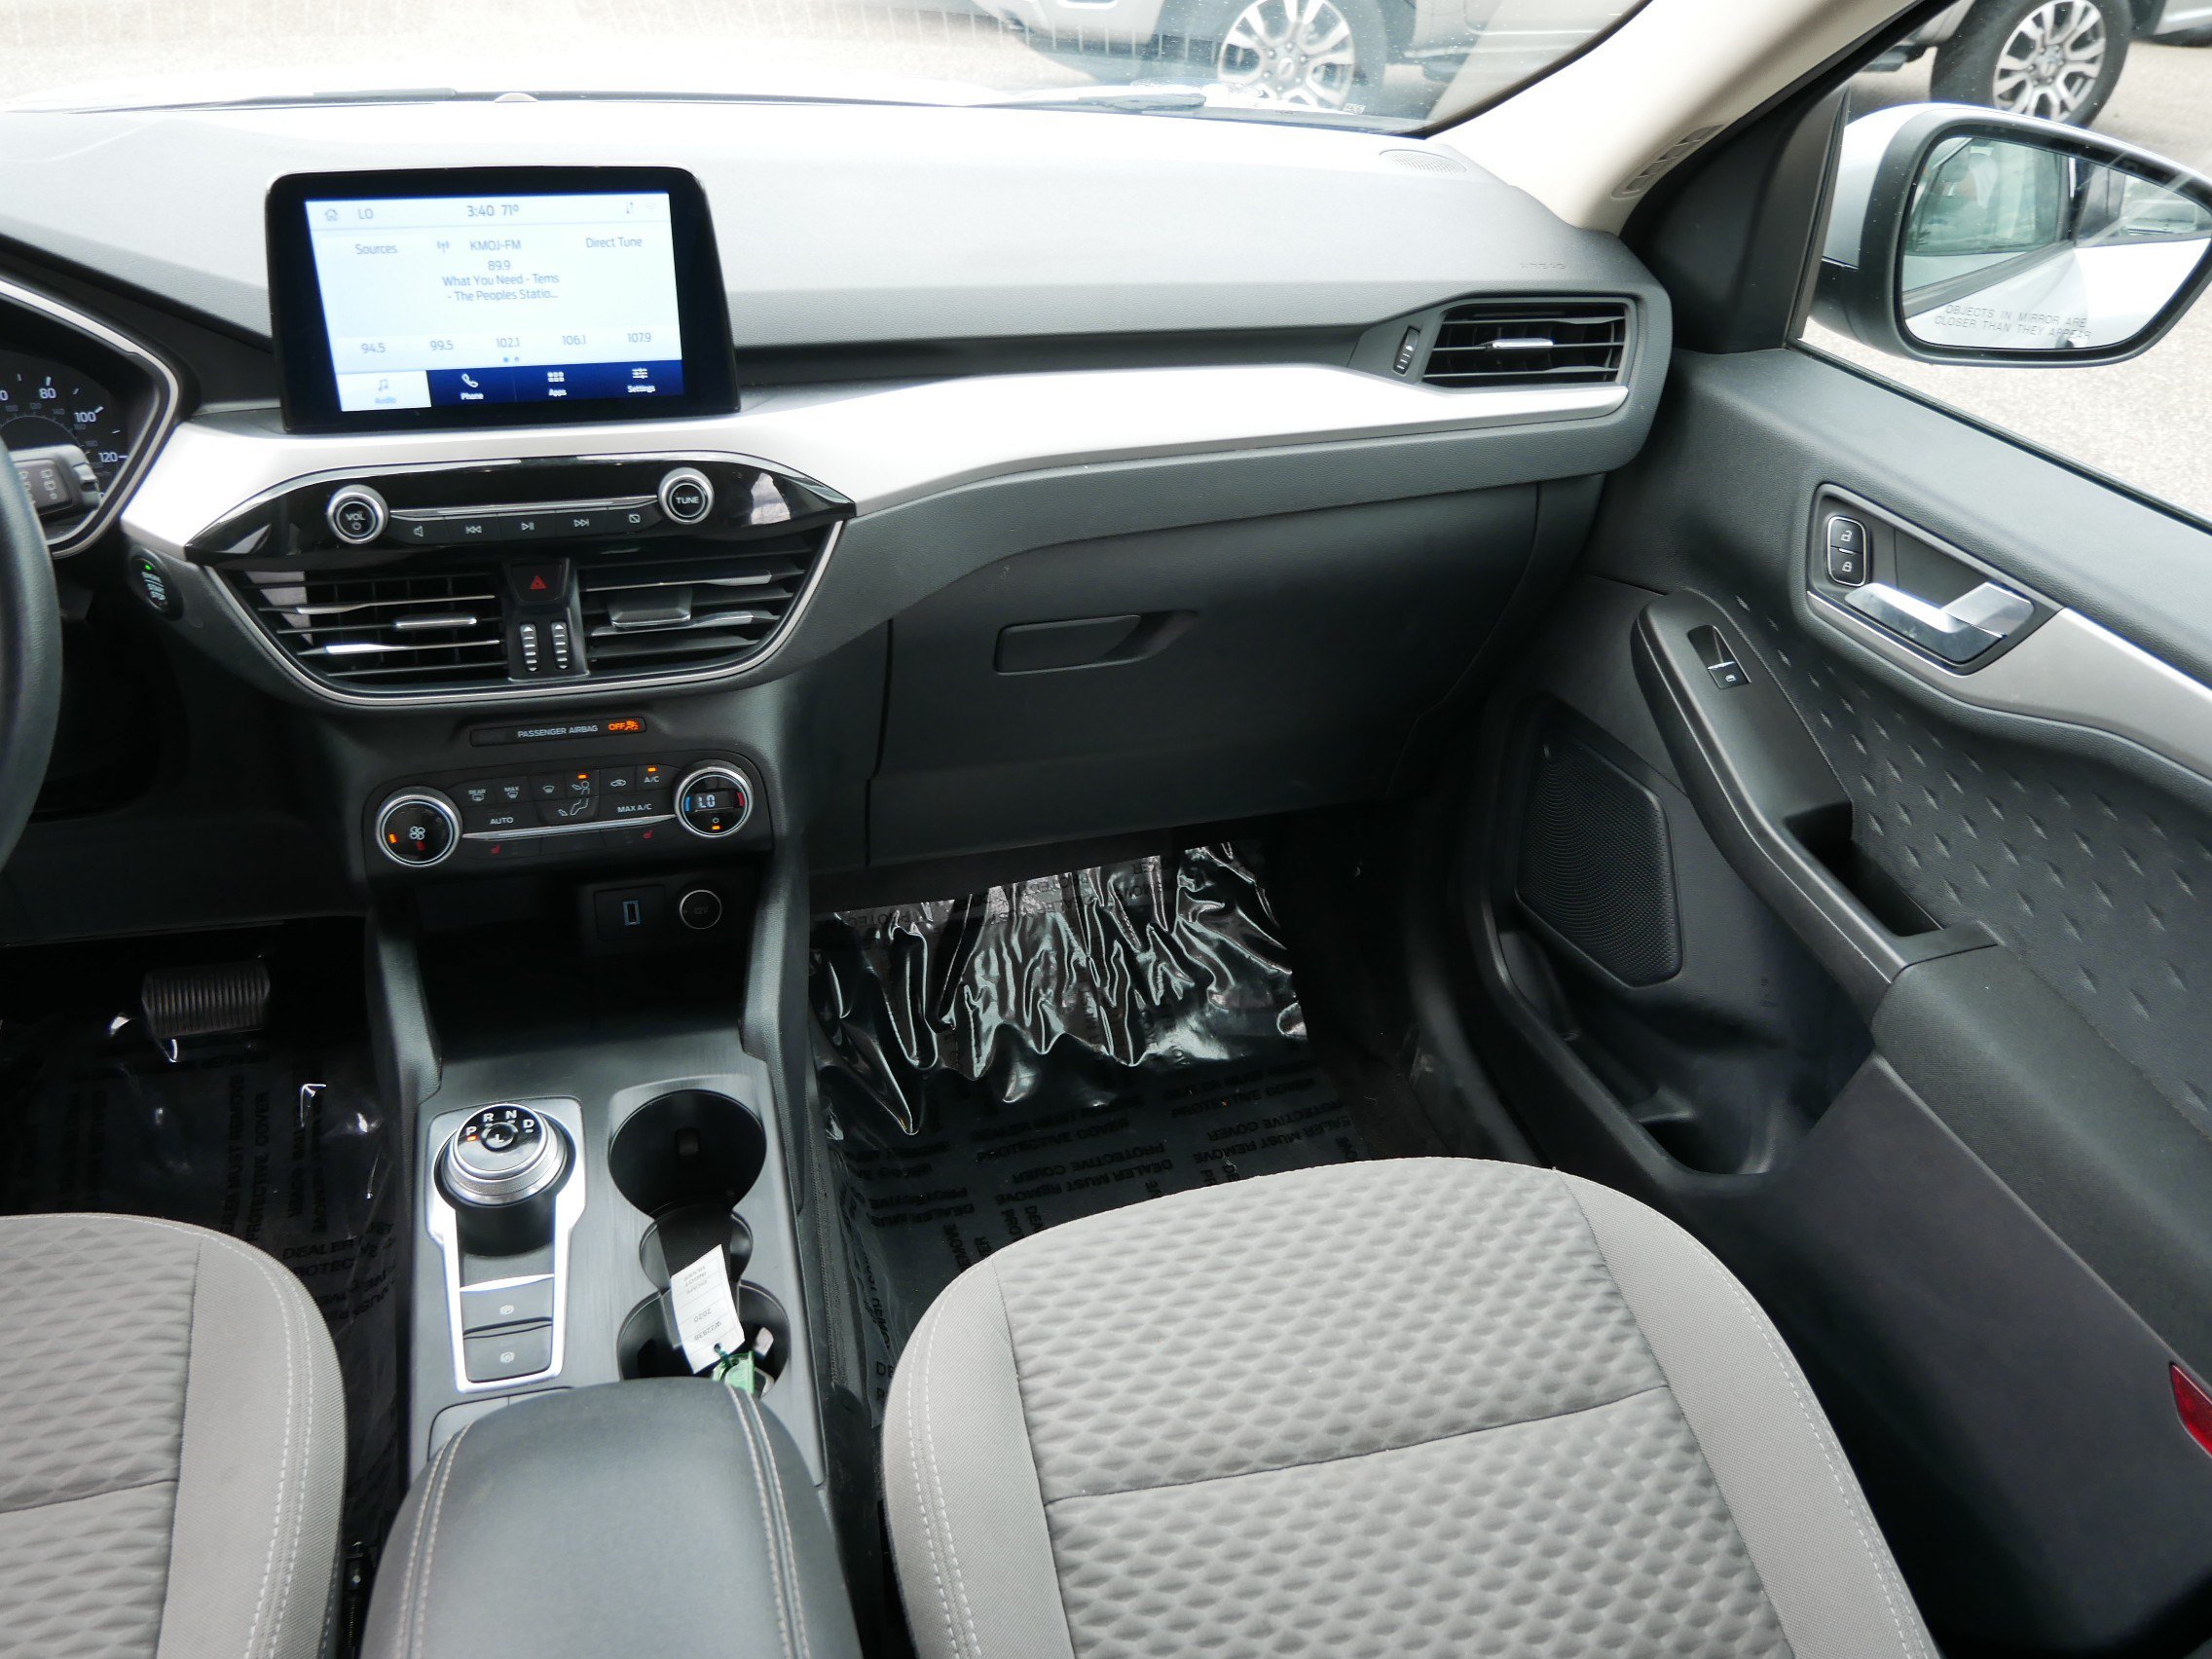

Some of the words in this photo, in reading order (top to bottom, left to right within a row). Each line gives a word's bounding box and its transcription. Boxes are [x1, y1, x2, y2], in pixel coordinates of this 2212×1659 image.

[357, 207, 375, 220] LO
[466, 204, 496, 218] 3:40
[468, 239, 522, 252] KMOJ-FM
[585, 236, 615, 248] Direct
[617, 236, 644, 247] Tune
[354, 242, 399, 255] Sources
[487, 260, 512, 272] 89.9
[441, 276, 471, 287] What
[472, 275, 495, 287] You
[495, 274, 525, 285] Need
[532, 273, 561, 284] Tems
[454, 290, 475, 302] The
[475, 289, 517, 303] Peoples
[1944, 304, 1995, 319] OBJECTS
[2000, 310, 2012, 320] IN
[2017, 312, 2061, 326] MIRROR
[2065, 316, 2088, 329] ARE
[1934, 314, 1977, 329] CLOSER
[1982, 320, 2012, 333] THAN
[2016, 322, 2046, 337] THEY
[495, 337, 521, 349] 102.1
[562, 334, 587, 347] 106.1
[626, 331, 653, 344] 107.9
[360, 343, 387, 354] 94.5
[429, 340, 455, 350] 99.5
[39, 387, 56, 399] 80
[548, 387, 568, 398] Apps
[626, 384, 656, 394] Settings
[374, 394, 397, 405] Audio
[460, 391, 485, 401] Phone
[74, 411, 97, 424] 100
[98, 452, 118, 462] 120
[675, 496, 700, 505] TUNE
[345, 511, 366, 522] VOL
[517, 726, 568, 739] PASSENGER
[569, 724, 599, 735] AIRBAG
[608, 721, 626, 732] OFF
[644, 775, 660, 785] A/C
[468, 788, 487, 797] REAR
[503, 786, 520, 794] MAX
[616, 804, 636, 814] MAX
[636, 801, 653, 812] A/C
[489, 816, 515, 826] AUTO
[484, 1113, 495, 1123] R
[505, 1110, 517, 1120] N
[523, 1120, 535, 1128] D
[1302, 1115, 1351, 1137] EALER
[465, 1126, 476, 1136] P
[1206, 1121, 1260, 1142] COVER
[495, 1133, 504, 1142] L
[1070, 1142, 1166, 1173] PROTECTIVE
[1192, 1140, 1258, 1163] REMOVE
[1012, 1164, 1066, 1186] COVER
[1113, 1159, 1174, 1183] DEALER
[1063, 1172, 1111, 1193] MUST
[994, 1183, 1062, 1206] REMOVE
[220, 1193, 241, 1234] EALER
